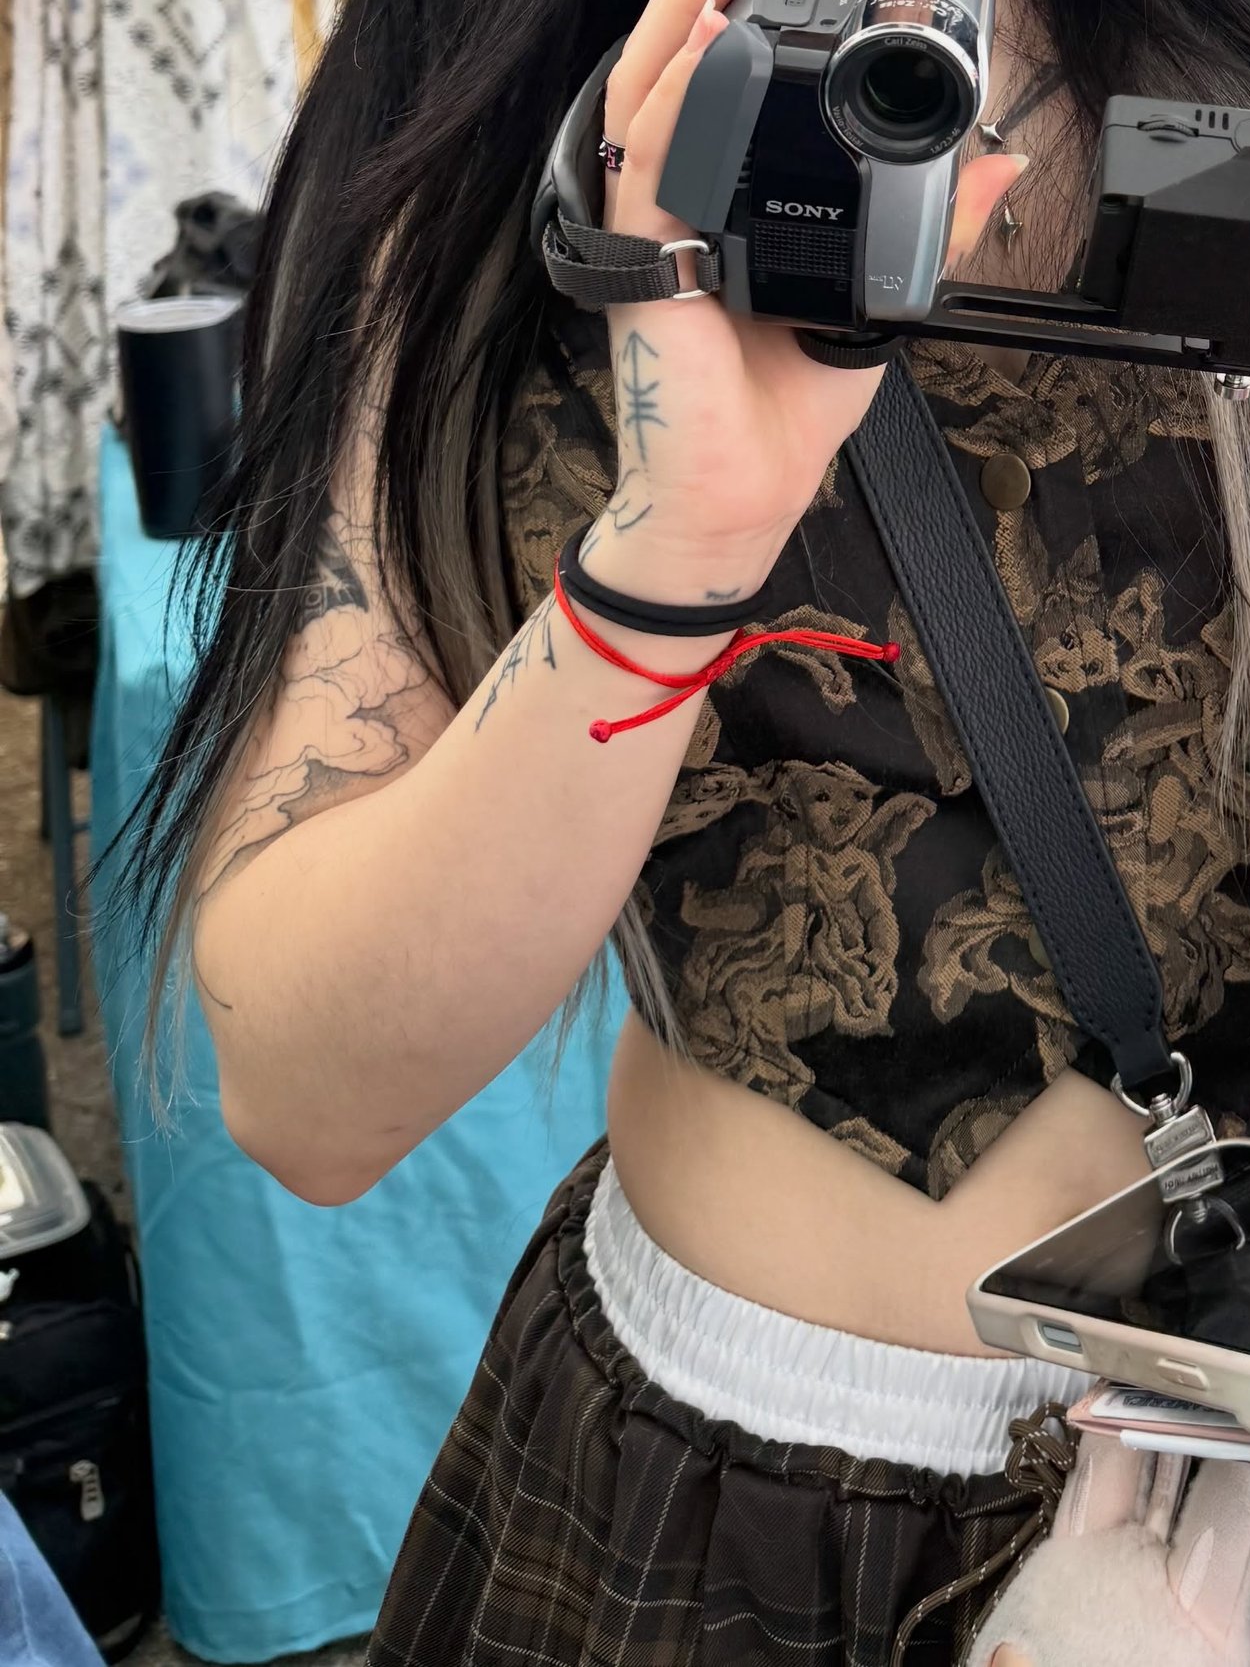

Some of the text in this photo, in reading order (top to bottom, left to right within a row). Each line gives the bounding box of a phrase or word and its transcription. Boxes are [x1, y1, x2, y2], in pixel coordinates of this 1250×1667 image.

[884, 37, 928, 50] Carl Zeiss
[765, 200, 844, 221] SONY
